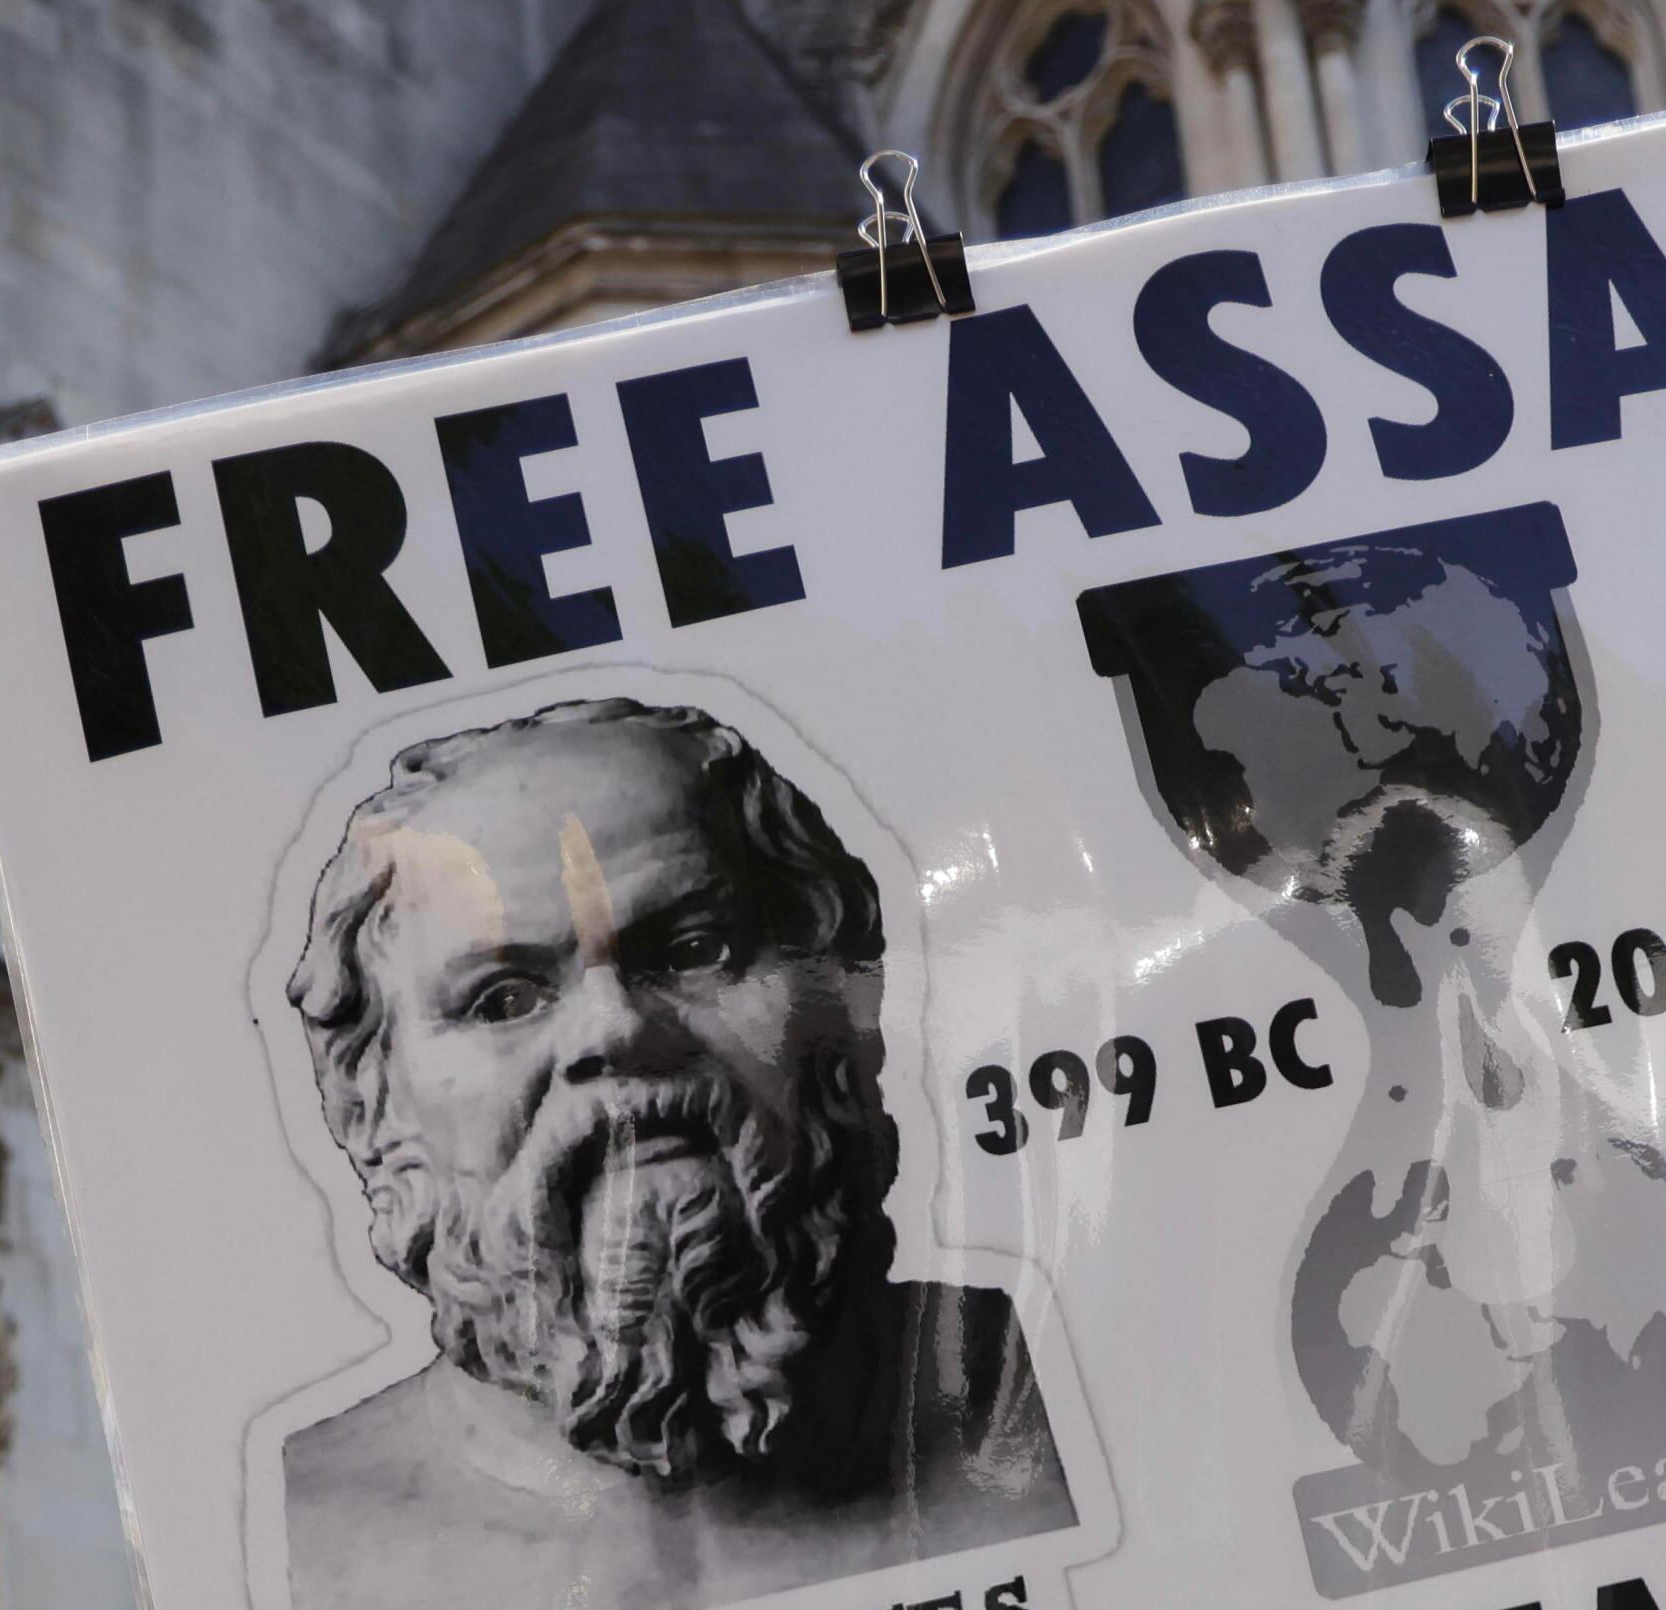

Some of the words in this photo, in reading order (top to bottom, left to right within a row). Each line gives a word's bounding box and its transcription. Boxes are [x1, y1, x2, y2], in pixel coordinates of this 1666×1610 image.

[36, 355, 808, 764] FREE
[965, 1034, 1159, 1157] 399
[1194, 997, 1335, 1110] BC
